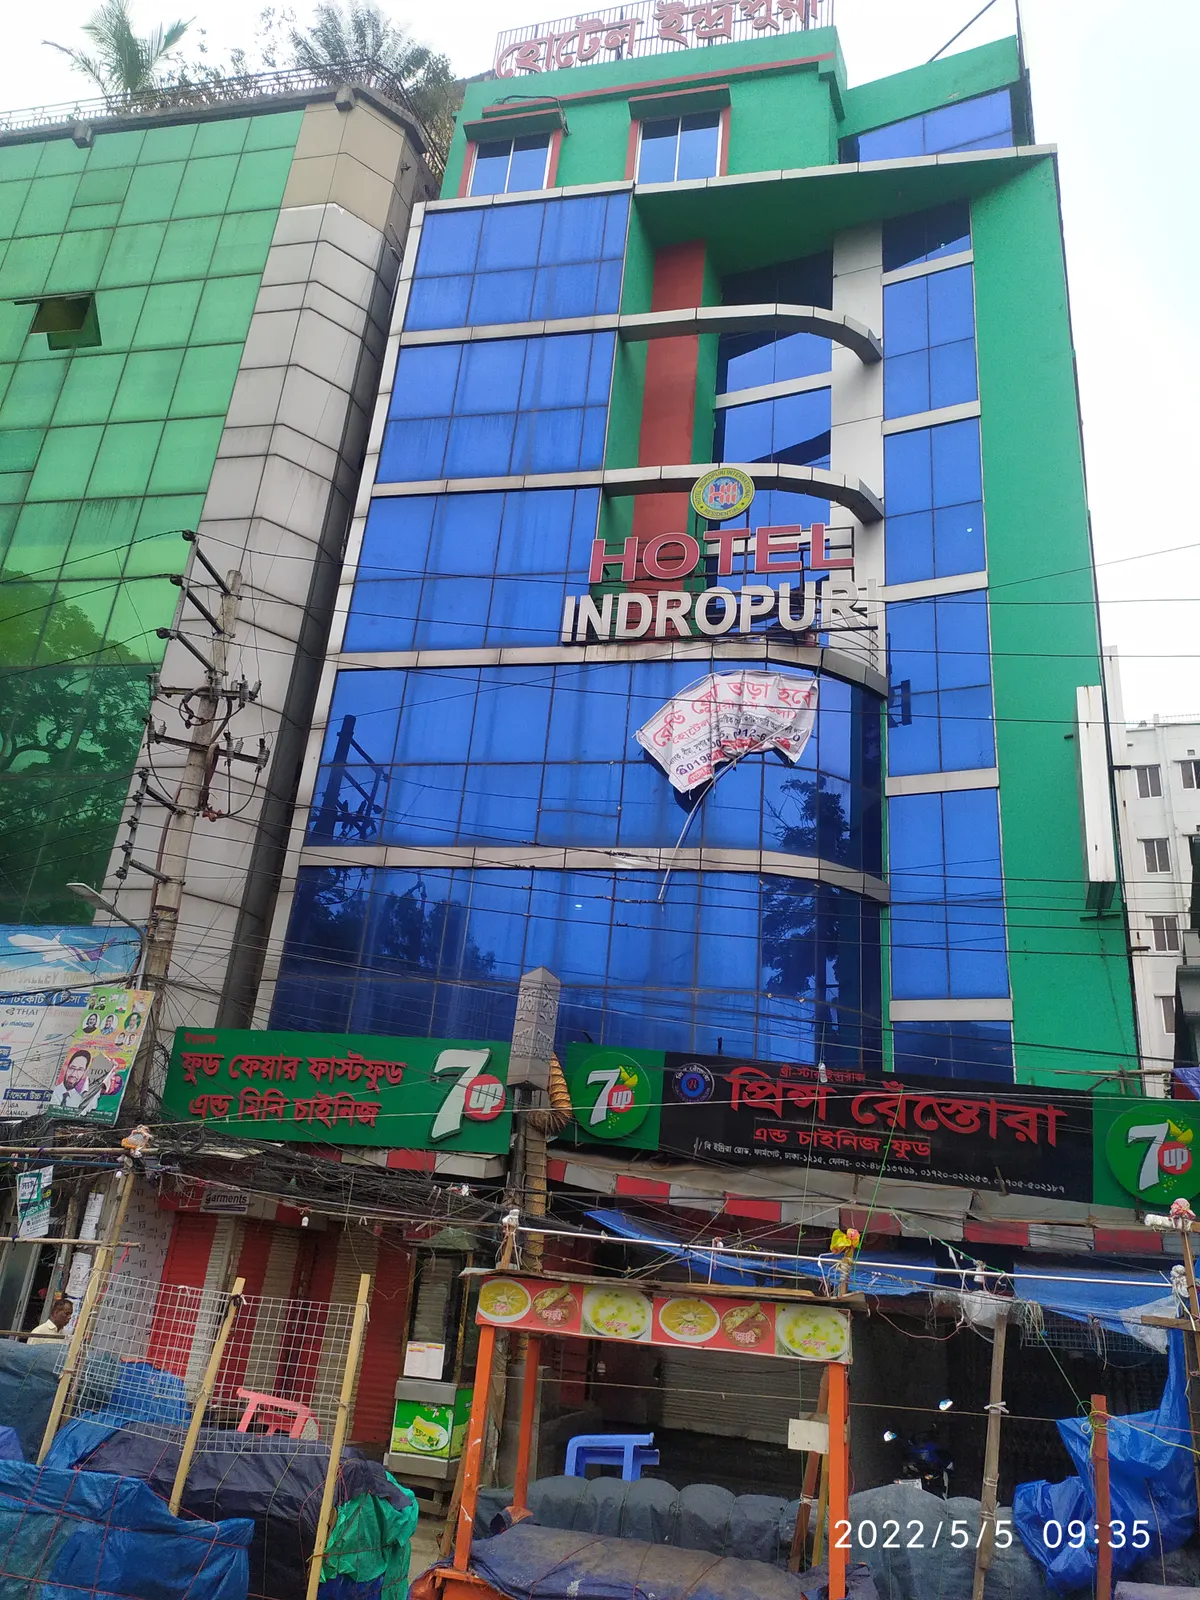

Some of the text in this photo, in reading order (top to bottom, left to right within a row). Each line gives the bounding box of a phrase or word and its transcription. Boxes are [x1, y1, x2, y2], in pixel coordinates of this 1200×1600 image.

[497, 17, 643, 79] হোটেল
[588, 523, 854, 583] HOTEL
[562, 578, 879, 643] INDROPURI
[652, 709, 687, 748] রেডি
[777, 688, 815, 709] হবে
[181, 1052, 407, 1094] ফুড ফেয়ার ফাস্টফুড
[189, 1087, 382, 1129] এন্ড মিনি চাইনিজ
[723, 1067, 1068, 1148] প্রিন্স রেঁস্তোরা
[754, 1128, 930, 1160] এন্ড চাইনিজ ফুড
[205, 1192, 248, 1205] garments
[993, 1177, 1065, 1194] ০৭০৫-৫০২১৮৭
